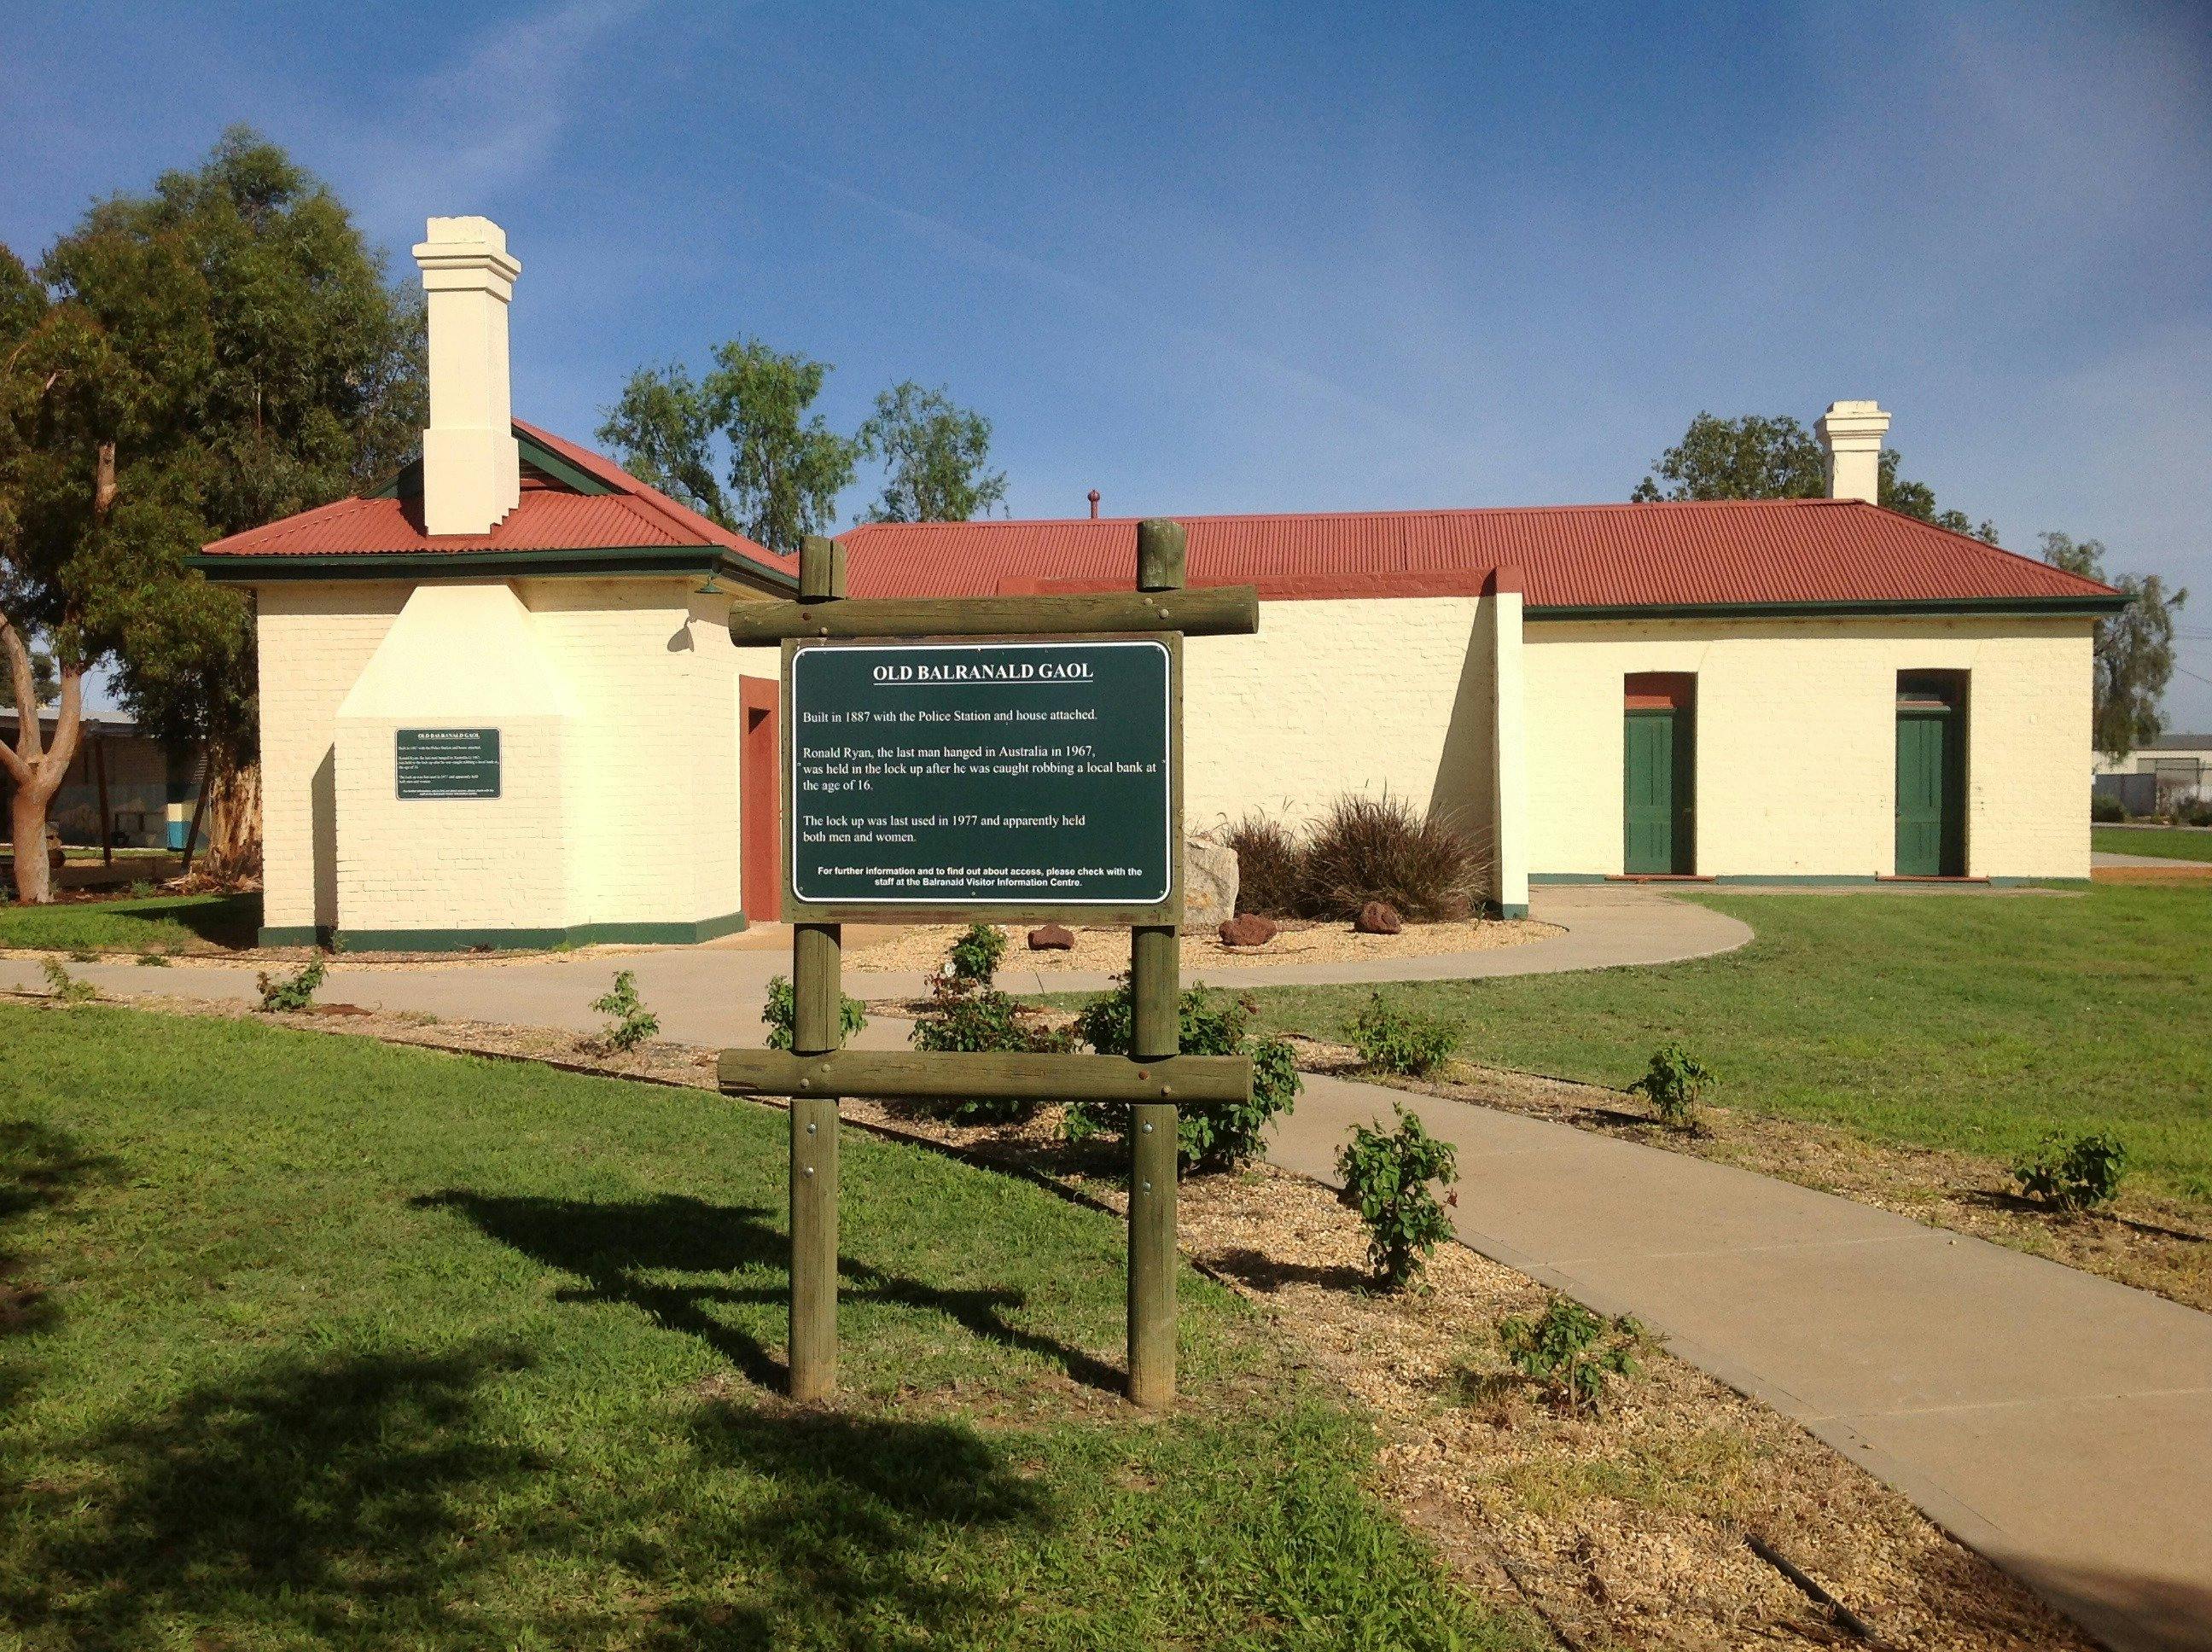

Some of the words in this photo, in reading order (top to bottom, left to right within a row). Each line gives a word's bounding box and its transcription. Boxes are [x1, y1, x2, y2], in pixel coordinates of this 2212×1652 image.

[873, 666, 913, 680] OLD
[917, 665, 1034, 679] BALRANALD
[1039, 664, 1094, 678] GAOL
[803, 712, 829, 722] Built
[831, 713, 842, 722] in
[846, 712, 870, 722] 1887
[873, 712, 897, 721] with
[899, 711, 916, 721] the
[918, 711, 952, 721] Police
[953, 711, 991, 721] Station
[993, 710, 1013, 721] and
[1016, 711, 1048, 720] house
[1050, 709, 1097, 719] attached.
[803, 747, 841, 758] Ronald
[843, 747, 875, 760] Ryan,
[876, 747, 894, 757] the
[896, 747, 915, 757] last
[943, 747, 983, 759] hanged
[985, 747, 997, 757] in
[998, 746, 1049, 757] Australia
[1066, 746, 1096, 759] 1967,
[826, 764, 849, 774] held
[851, 765, 863, 774] in
[864, 763, 882, 774] the
[884, 763, 907, 773] lock
[910, 766, 923, 777] up
[926, 763, 952, 774] after
[953, 763, 967, 773] he
[992, 762, 1029, 776] caught
[1032, 762, 1074, 775] robbing
[1086, 762, 1113, 772] local
[1115, 762, 1144, 772] bank
[1146, 764, 1157, 772] at
[803, 780, 819, 790] the
[822, 782, 841, 793] age
[842, 780, 857, 790] of
[858, 780, 874, 790] 16.
[803, 816, 824, 825] The
[826, 816, 848, 825] lock
[851, 818, 864, 829] up
[890, 815, 909, 825] last
[911, 815, 935, 825] used
[938, 815, 949, 825] in
[952, 816, 978, 825] 1977
[980, 815, 1000, 825] and
[1003, 815, 1060, 828] apparently
[1062, 815, 1086, 825] held
[803, 831, 826, 841] both
[853, 831, 873, 841] and
[834, 867, 864, 875] further
[946, 867, 964, 875] find
[1045, 867, 1076, 876] please
[1077, 867, 1105, 875] check
[874, 877, 894, 886] staff
[906, 877, 921, 886] the
[997, 877, 1049, 886] Information
